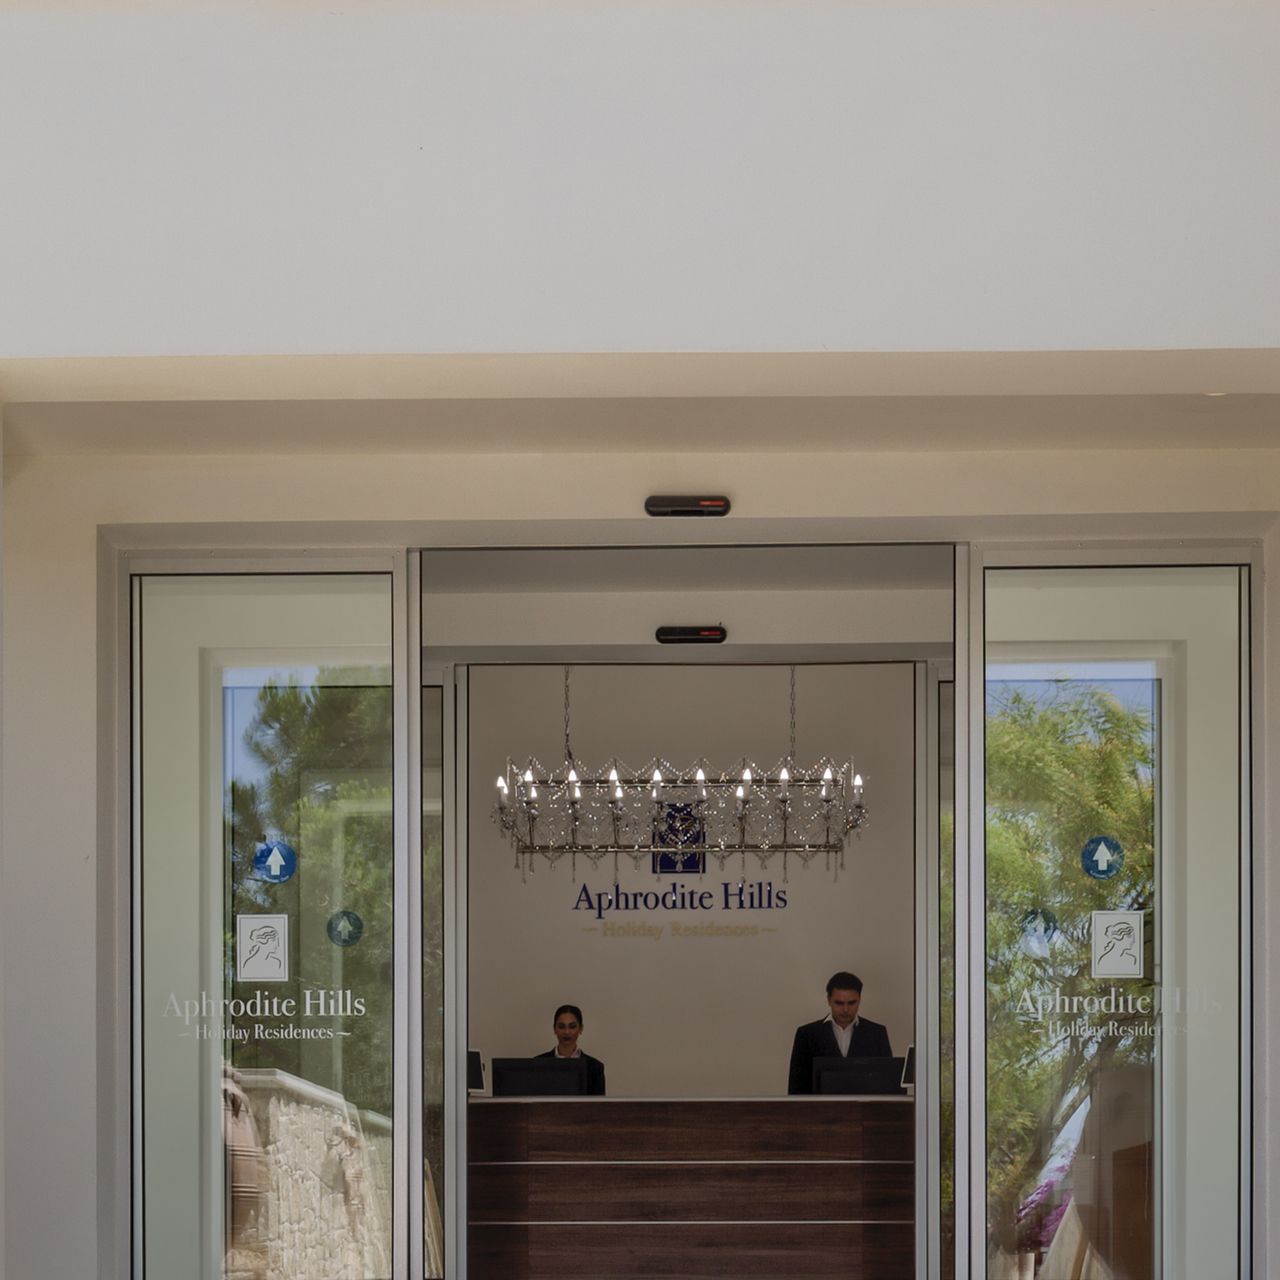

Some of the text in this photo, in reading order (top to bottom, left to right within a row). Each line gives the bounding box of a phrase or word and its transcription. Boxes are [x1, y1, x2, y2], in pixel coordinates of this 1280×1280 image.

[572, 881, 789, 920] Aphrodite Hills
[162, 989, 367, 1026] Aphrodite Hills
[1015, 986, 1152, 1022] Aphrodite
[195, 1023, 334, 1044] Hoiday Residences
